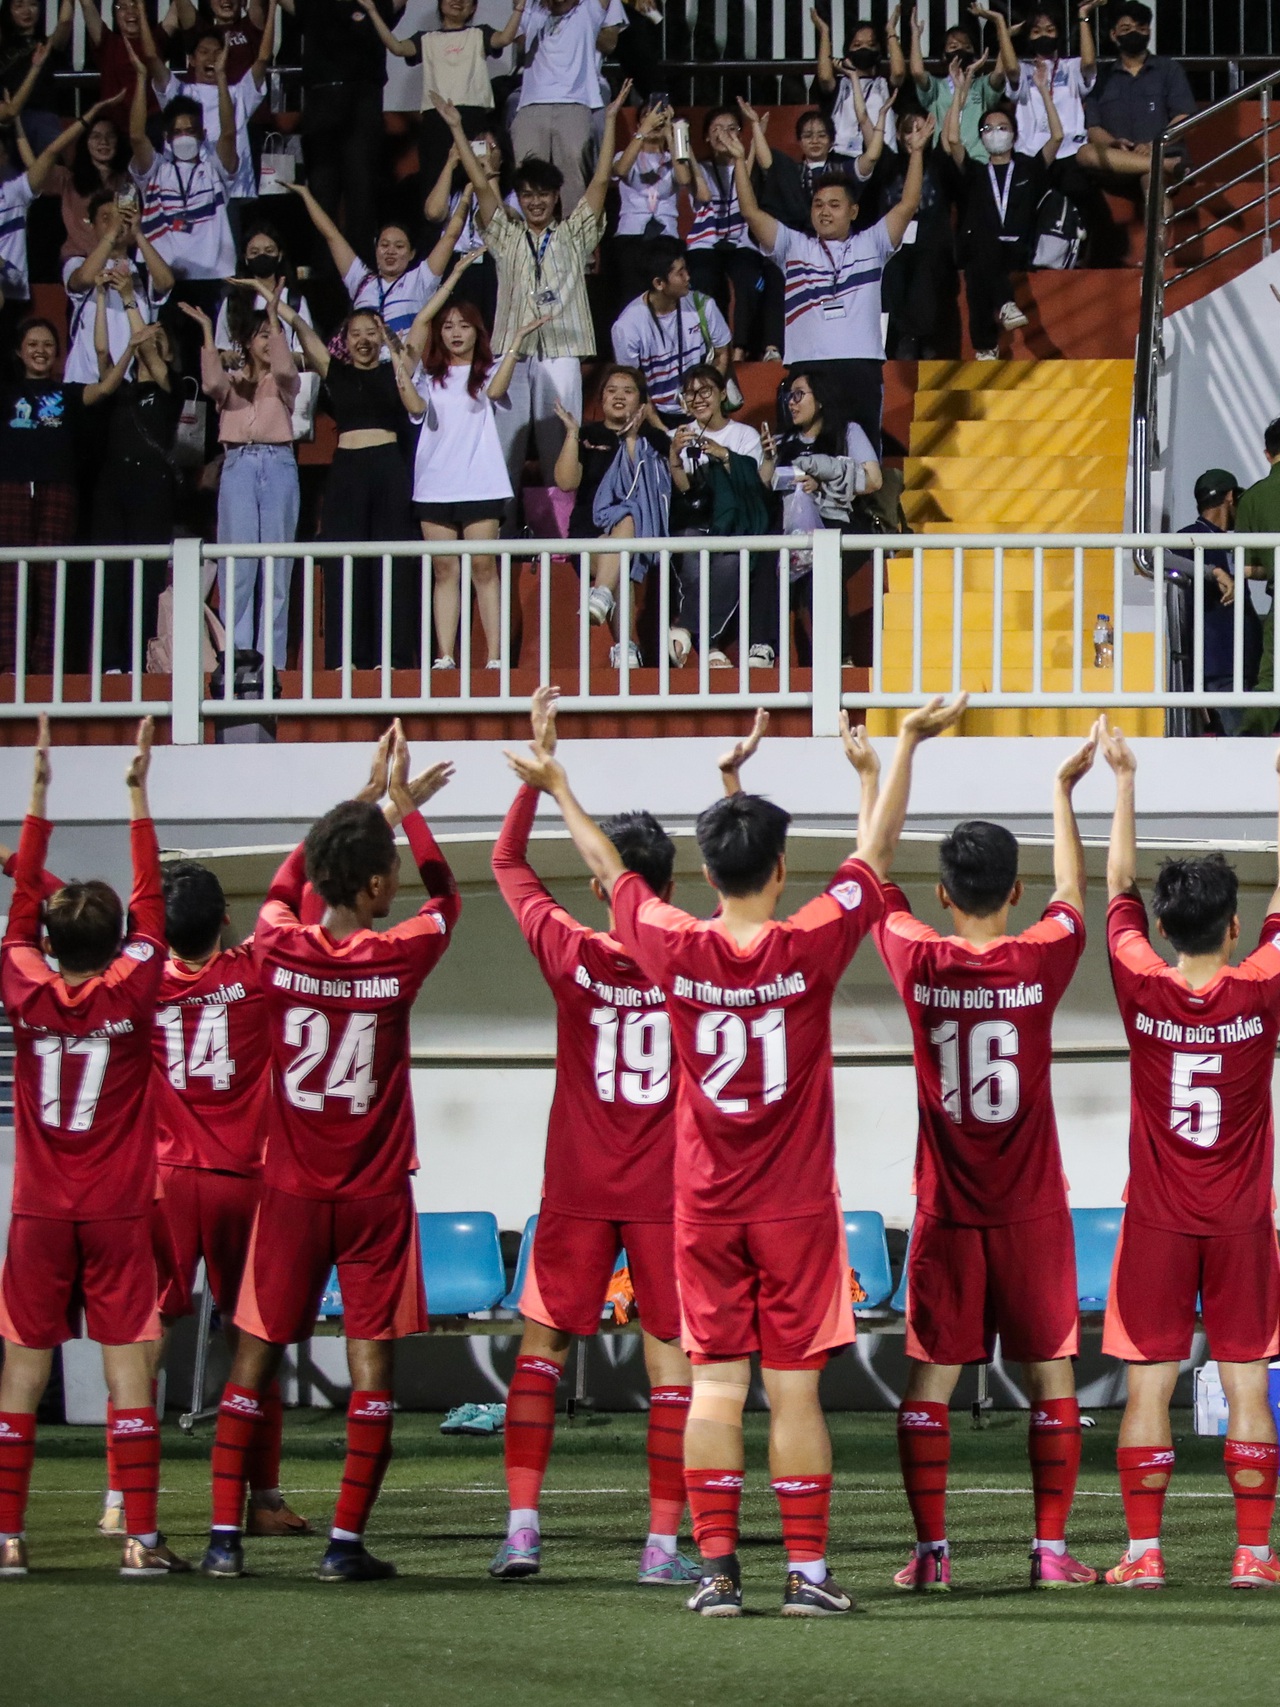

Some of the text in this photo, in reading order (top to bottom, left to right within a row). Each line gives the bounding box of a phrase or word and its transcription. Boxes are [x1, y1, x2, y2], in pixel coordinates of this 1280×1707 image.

[273, 966, 399, 998] ĐH TÔN ĐỨC THẮNG
[613, 986, 642, 1007] ĐỨC
[674, 975, 693, 998] ĐH
[695, 981, 723, 1006] TÔN
[757, 972, 806, 1002] THẮNG
[914, 981, 1043, 1009] ĐH TÔN ĐỨC THẮNG
[1135, 1012, 1264, 1043] ĐH TÔN ĐỨC THẮNG
[34, 1036, 110, 1132] 17
[156, 1003, 236, 1090] 14
[285, 1007, 378, 1114] 24
[590, 1005, 672, 1104] 19
[697, 1008, 788, 1114] 21
[930, 1020, 1020, 1124] 16
[1170, 1052, 1223, 1148] 5
